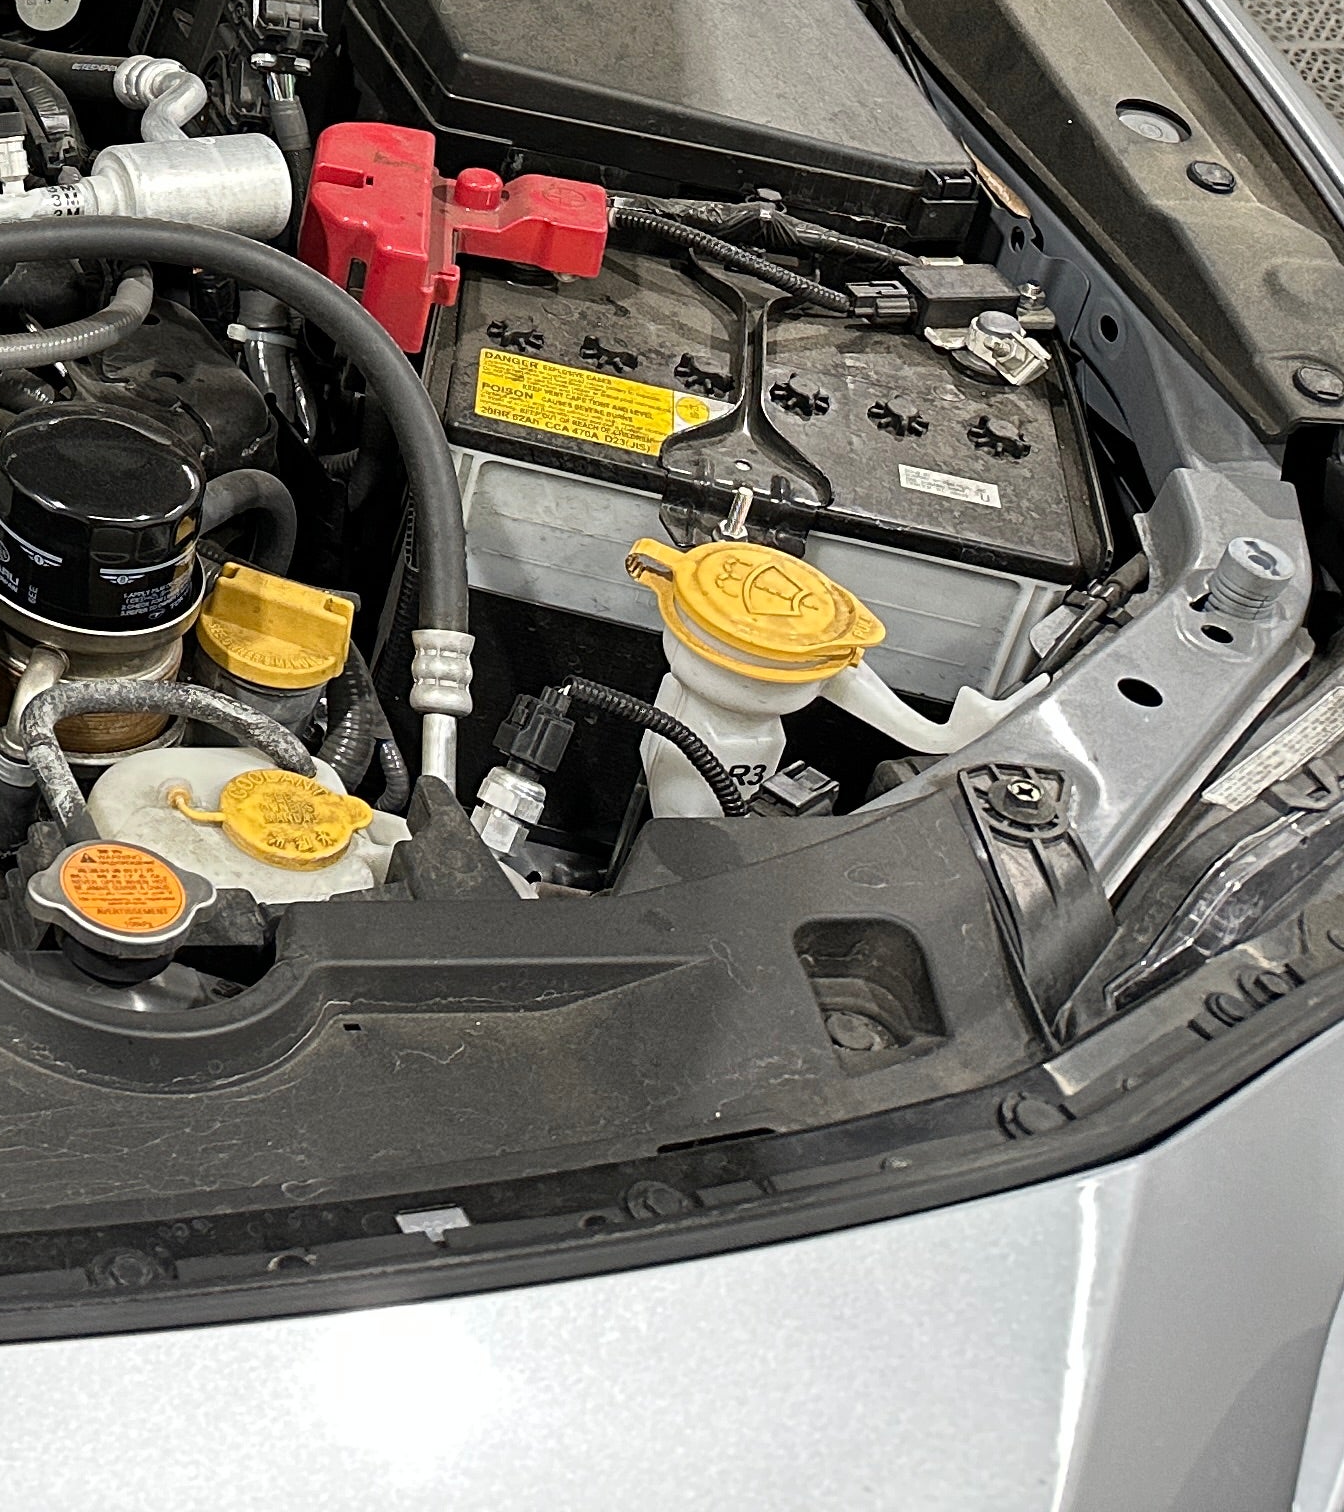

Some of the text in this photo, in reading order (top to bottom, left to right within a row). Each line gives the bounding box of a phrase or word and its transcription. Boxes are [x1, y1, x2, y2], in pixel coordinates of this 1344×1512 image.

[484, 352, 539, 369] DANGER
[482, 381, 534, 399] POISON
[545, 420, 570, 433] CCA
[572, 428, 599, 440] 470A
[227, 770, 329, 800] COOLANT
[728, 763, 768, 787] R3
